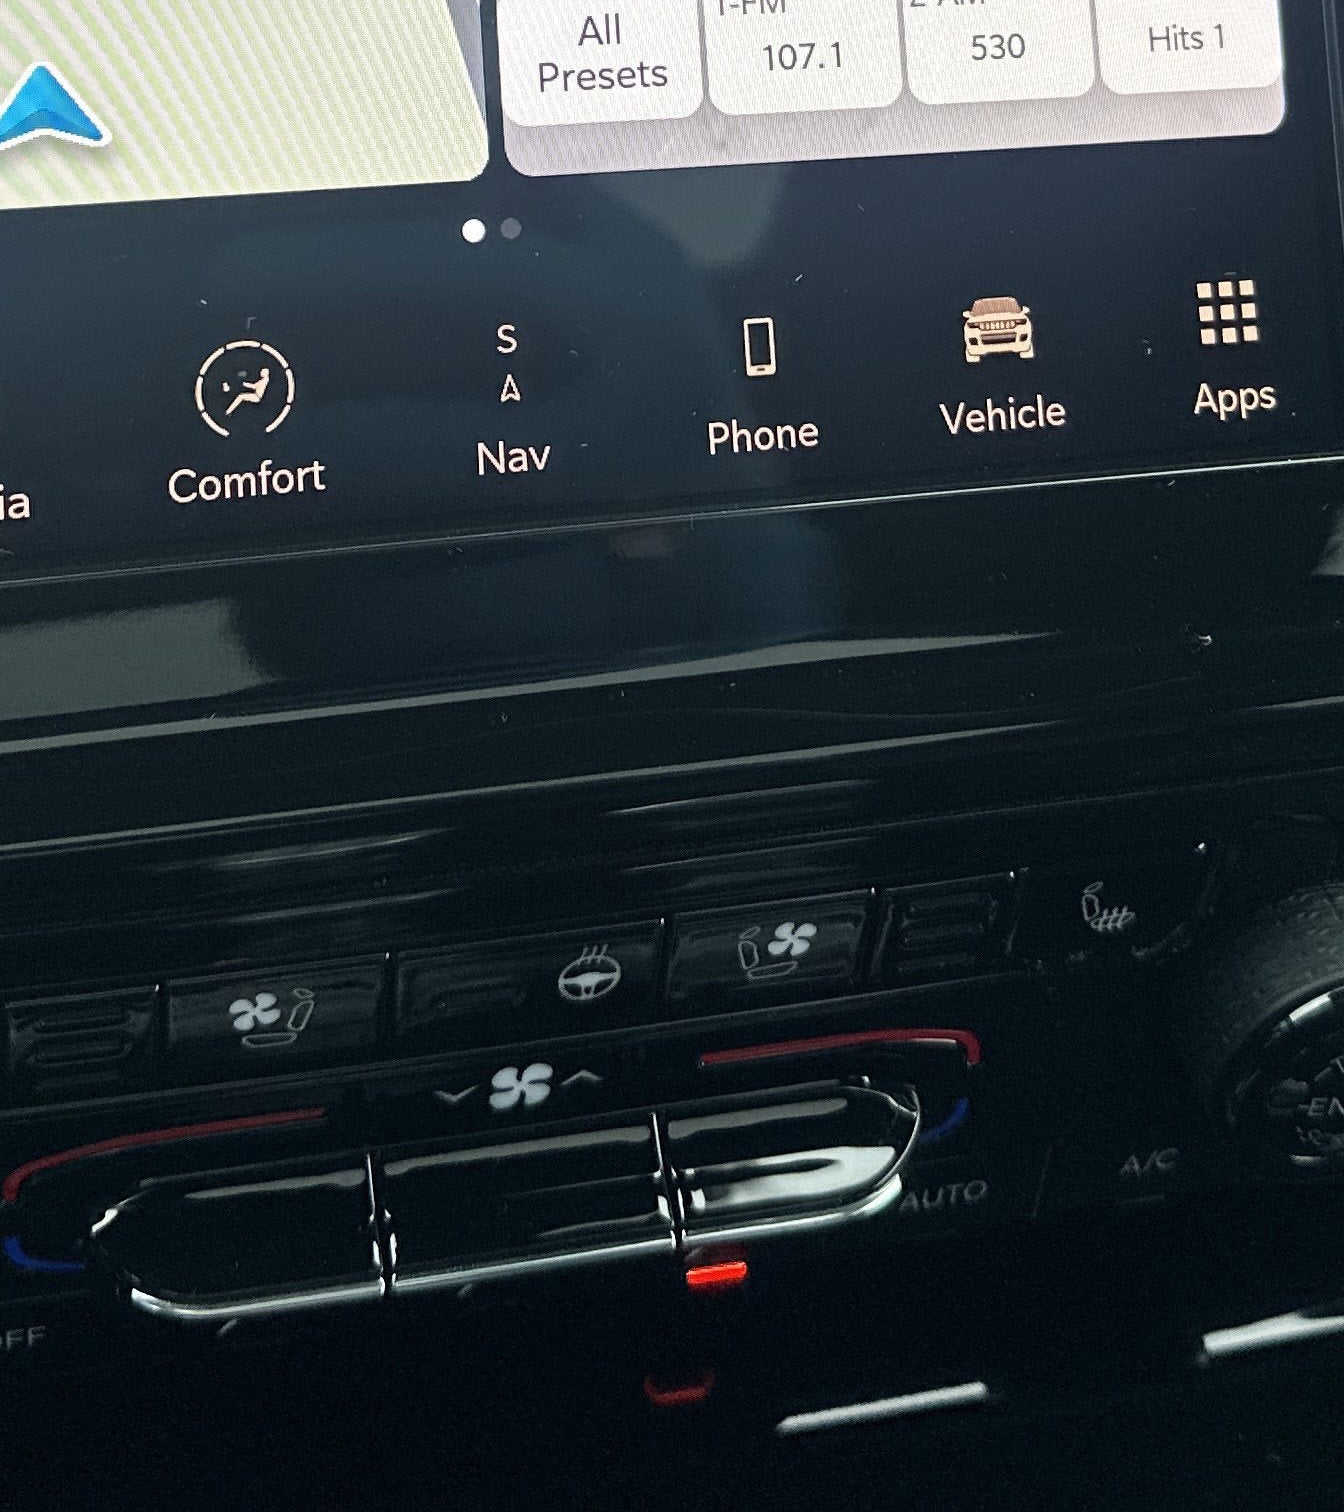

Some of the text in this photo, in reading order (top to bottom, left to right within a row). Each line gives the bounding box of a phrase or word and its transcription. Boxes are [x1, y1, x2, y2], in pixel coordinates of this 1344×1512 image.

[577, 12, 622, 46] All
[1148, 23, 1226, 54] Hits 1
[762, 41, 844, 73] 107.1
[970, 32, 1026, 63] 530
[537, 58, 669, 94] Presets
[496, 323, 518, 355] S
[938, 394, 1067, 436] Vehicle
[1193, 379, 1277, 420] Apps
[707, 416, 820, 456] Phone
[475, 439, 552, 477] Nav
[167, 458, 327, 505] Comfort
[1120, 1147, 1179, 1176] A/C
[900, 1179, 987, 1212] AUTO
